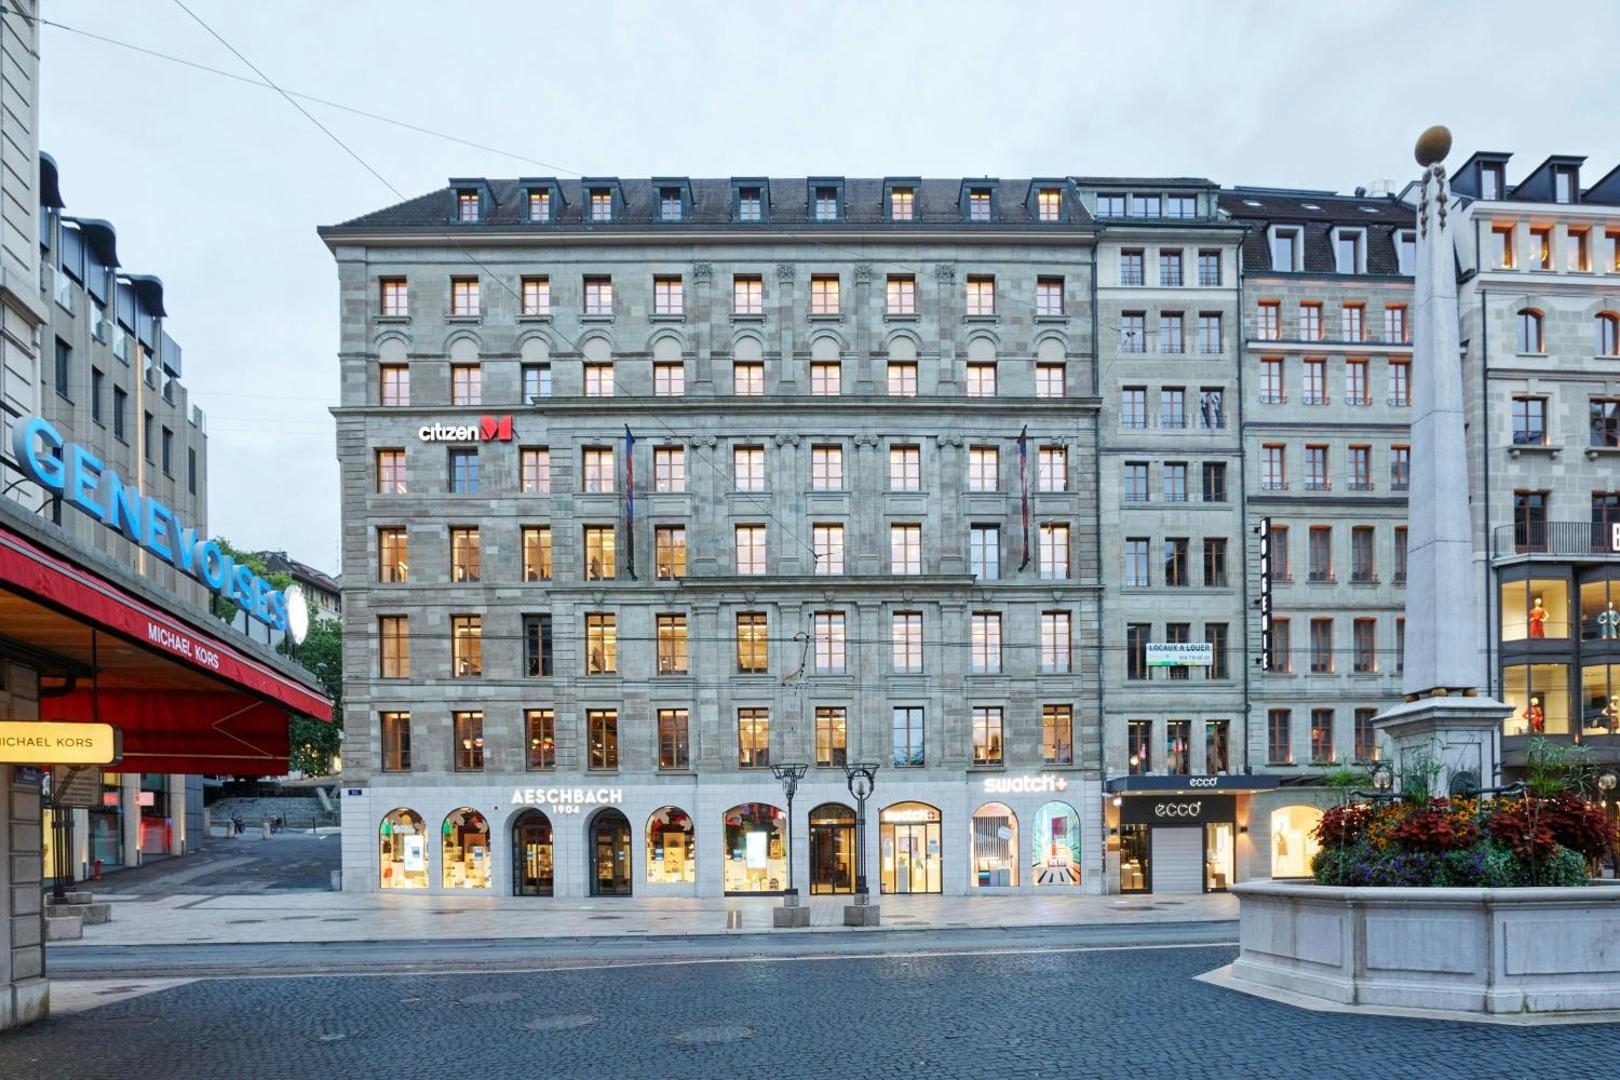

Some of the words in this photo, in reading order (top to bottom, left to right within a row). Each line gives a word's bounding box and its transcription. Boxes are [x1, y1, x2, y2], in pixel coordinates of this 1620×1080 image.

[12, 415, 287, 632] GENEVOISES
[147, 622, 193, 657] MICHAEL
[194, 644, 220, 670] KORS
[0, 737, 51, 747] ICHAEL
[56, 738, 93, 748] KORS
[983, 774, 1056, 793] swatch
[1189, 777, 1218, 787] ecco
[511, 789, 623, 804] AESCHBACH
[552, 805, 580, 814] 1904
[1154, 801, 1202, 818] ecco
